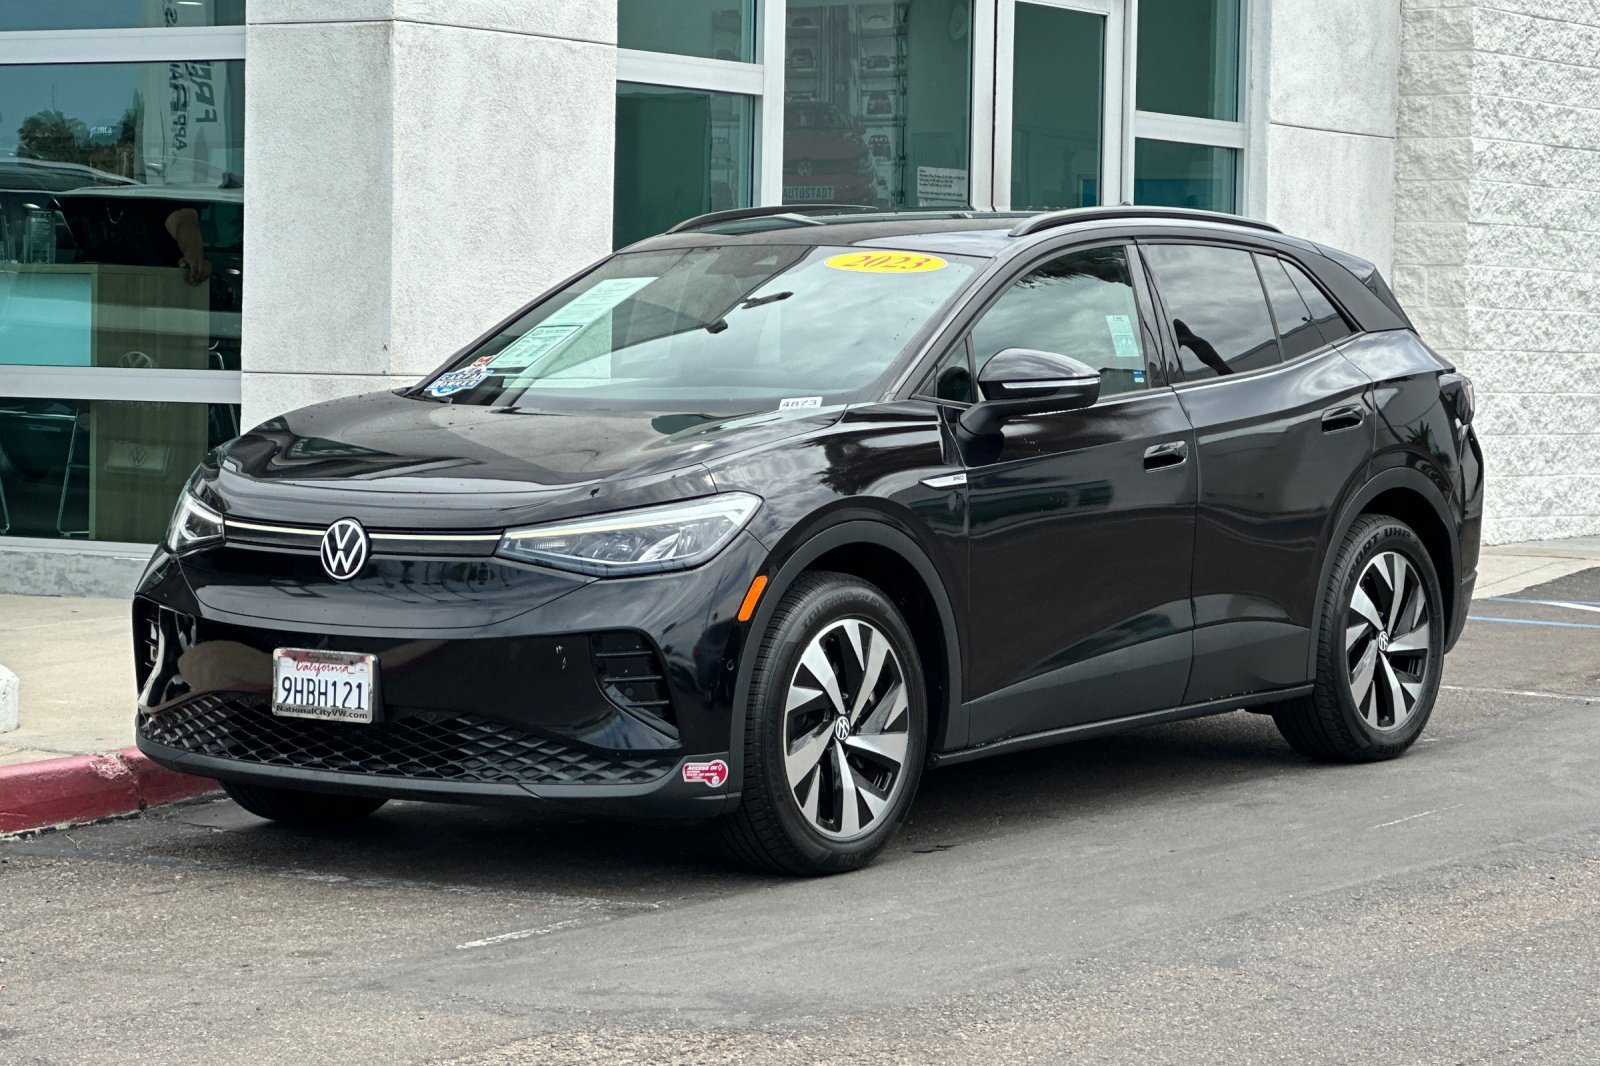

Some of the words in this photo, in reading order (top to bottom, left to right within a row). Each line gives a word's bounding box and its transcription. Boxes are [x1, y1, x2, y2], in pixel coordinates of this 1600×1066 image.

[783, 187, 832, 199] AUTOSTADT
[842, 255, 931, 270] 2023
[781, 399, 817, 408] 4873
[295, 661, 355, 676] California
[281, 676, 365, 710] 9HBH121
[276, 705, 368, 719] NationalCityVW.com
